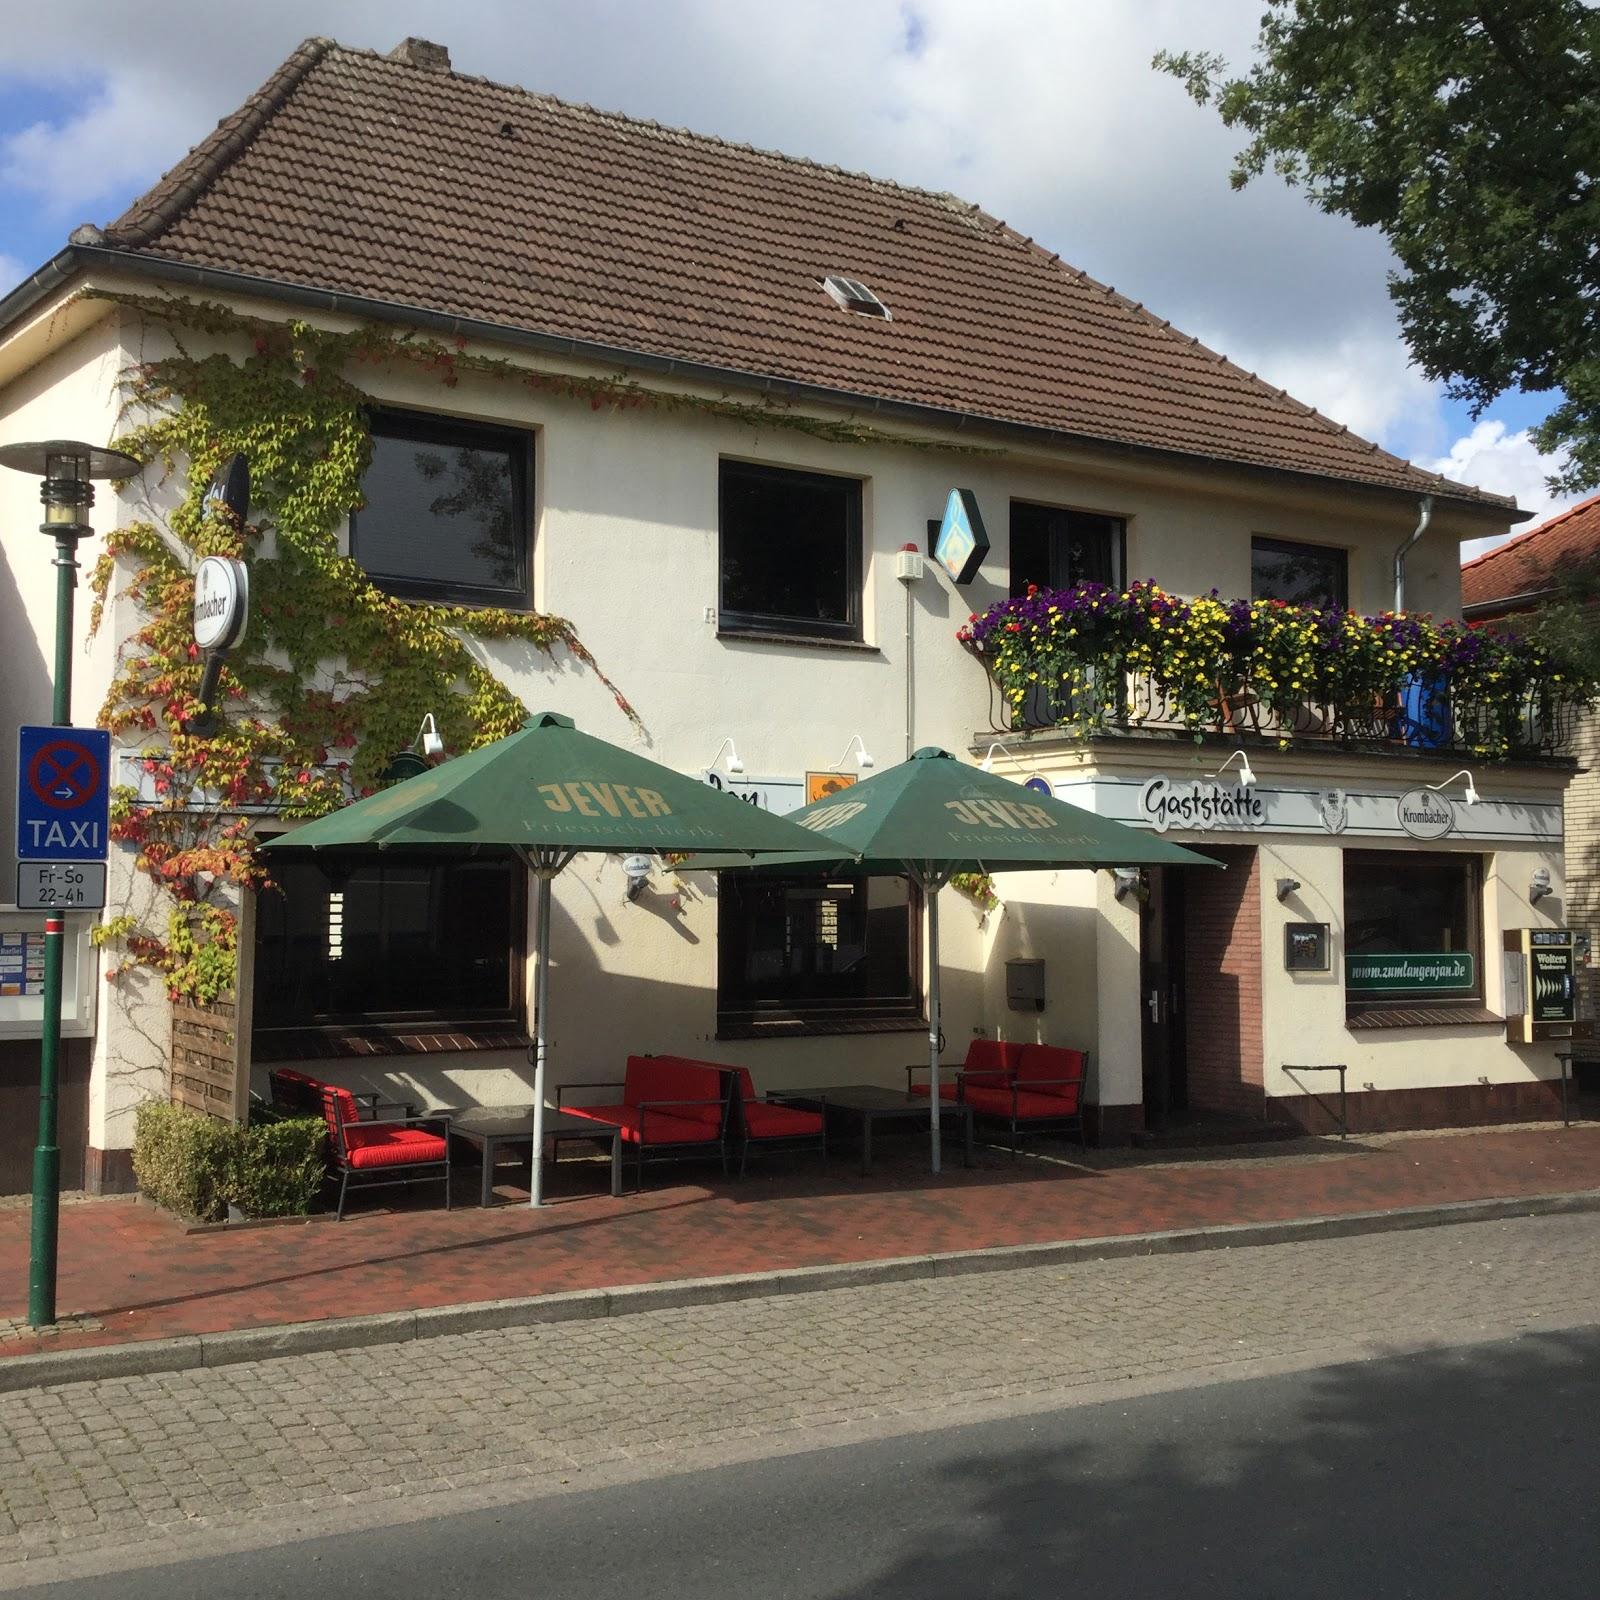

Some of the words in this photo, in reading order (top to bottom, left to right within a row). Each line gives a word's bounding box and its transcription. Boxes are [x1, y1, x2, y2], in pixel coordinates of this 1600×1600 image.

[537, 782, 673, 818] JEVER
[943, 799, 1059, 829] JEVER
[1145, 780, 1262, 824] Gaststätte
[1403, 807, 1449, 824] Krombacher
[26, 820, 99, 848] TAXI
[39, 869, 84, 884] Fr-So
[1351, 960, 1466, 981] www.zumlangenjan.de
